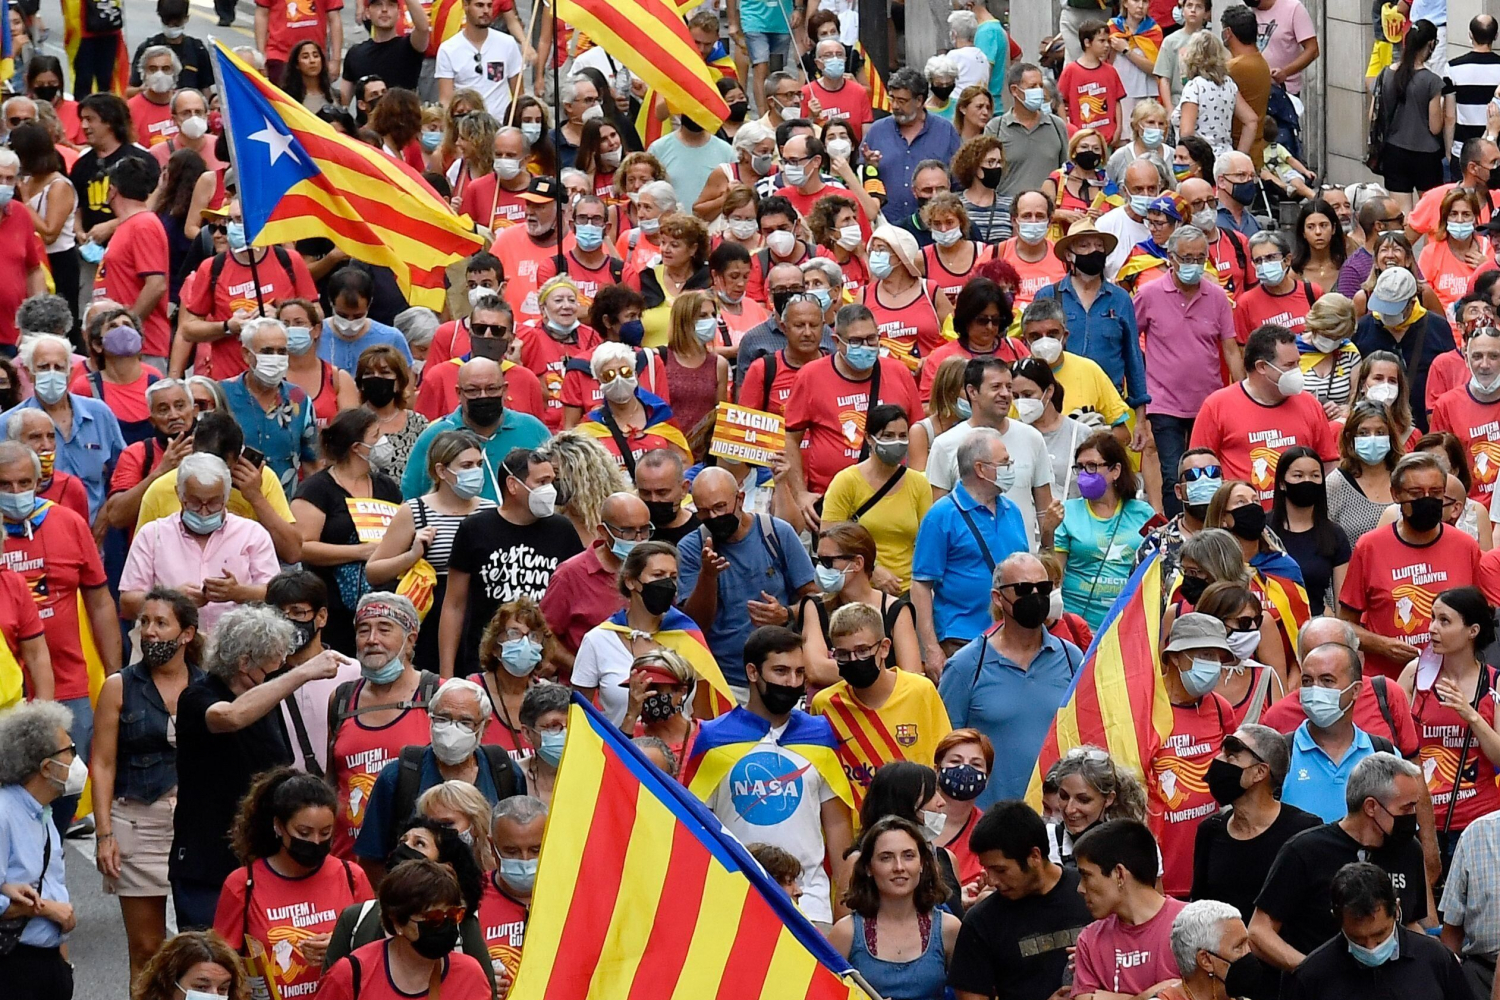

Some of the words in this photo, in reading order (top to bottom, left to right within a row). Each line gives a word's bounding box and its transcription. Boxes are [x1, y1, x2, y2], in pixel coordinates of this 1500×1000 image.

[726, 408, 780, 435] EXIGIM
[1469, 420, 1500, 439] LLUITEM
[744, 429, 757, 444] LA
[479, 562, 550, 588] t'estim
[1392, 563, 1428, 582] LLUITEM
[1412, 571, 1448, 586] GUANYEM
[1423, 725, 1459, 740] LLUITEM
[346, 747, 383, 769] LLUITEM
[1175, 742, 1213, 757] GUANYEM
[735, 780, 799, 799] NASA
[267, 902, 310, 921] LLUITEM
[311, 903, 316, 914] I
[294, 910, 337, 928] GUANYEM
